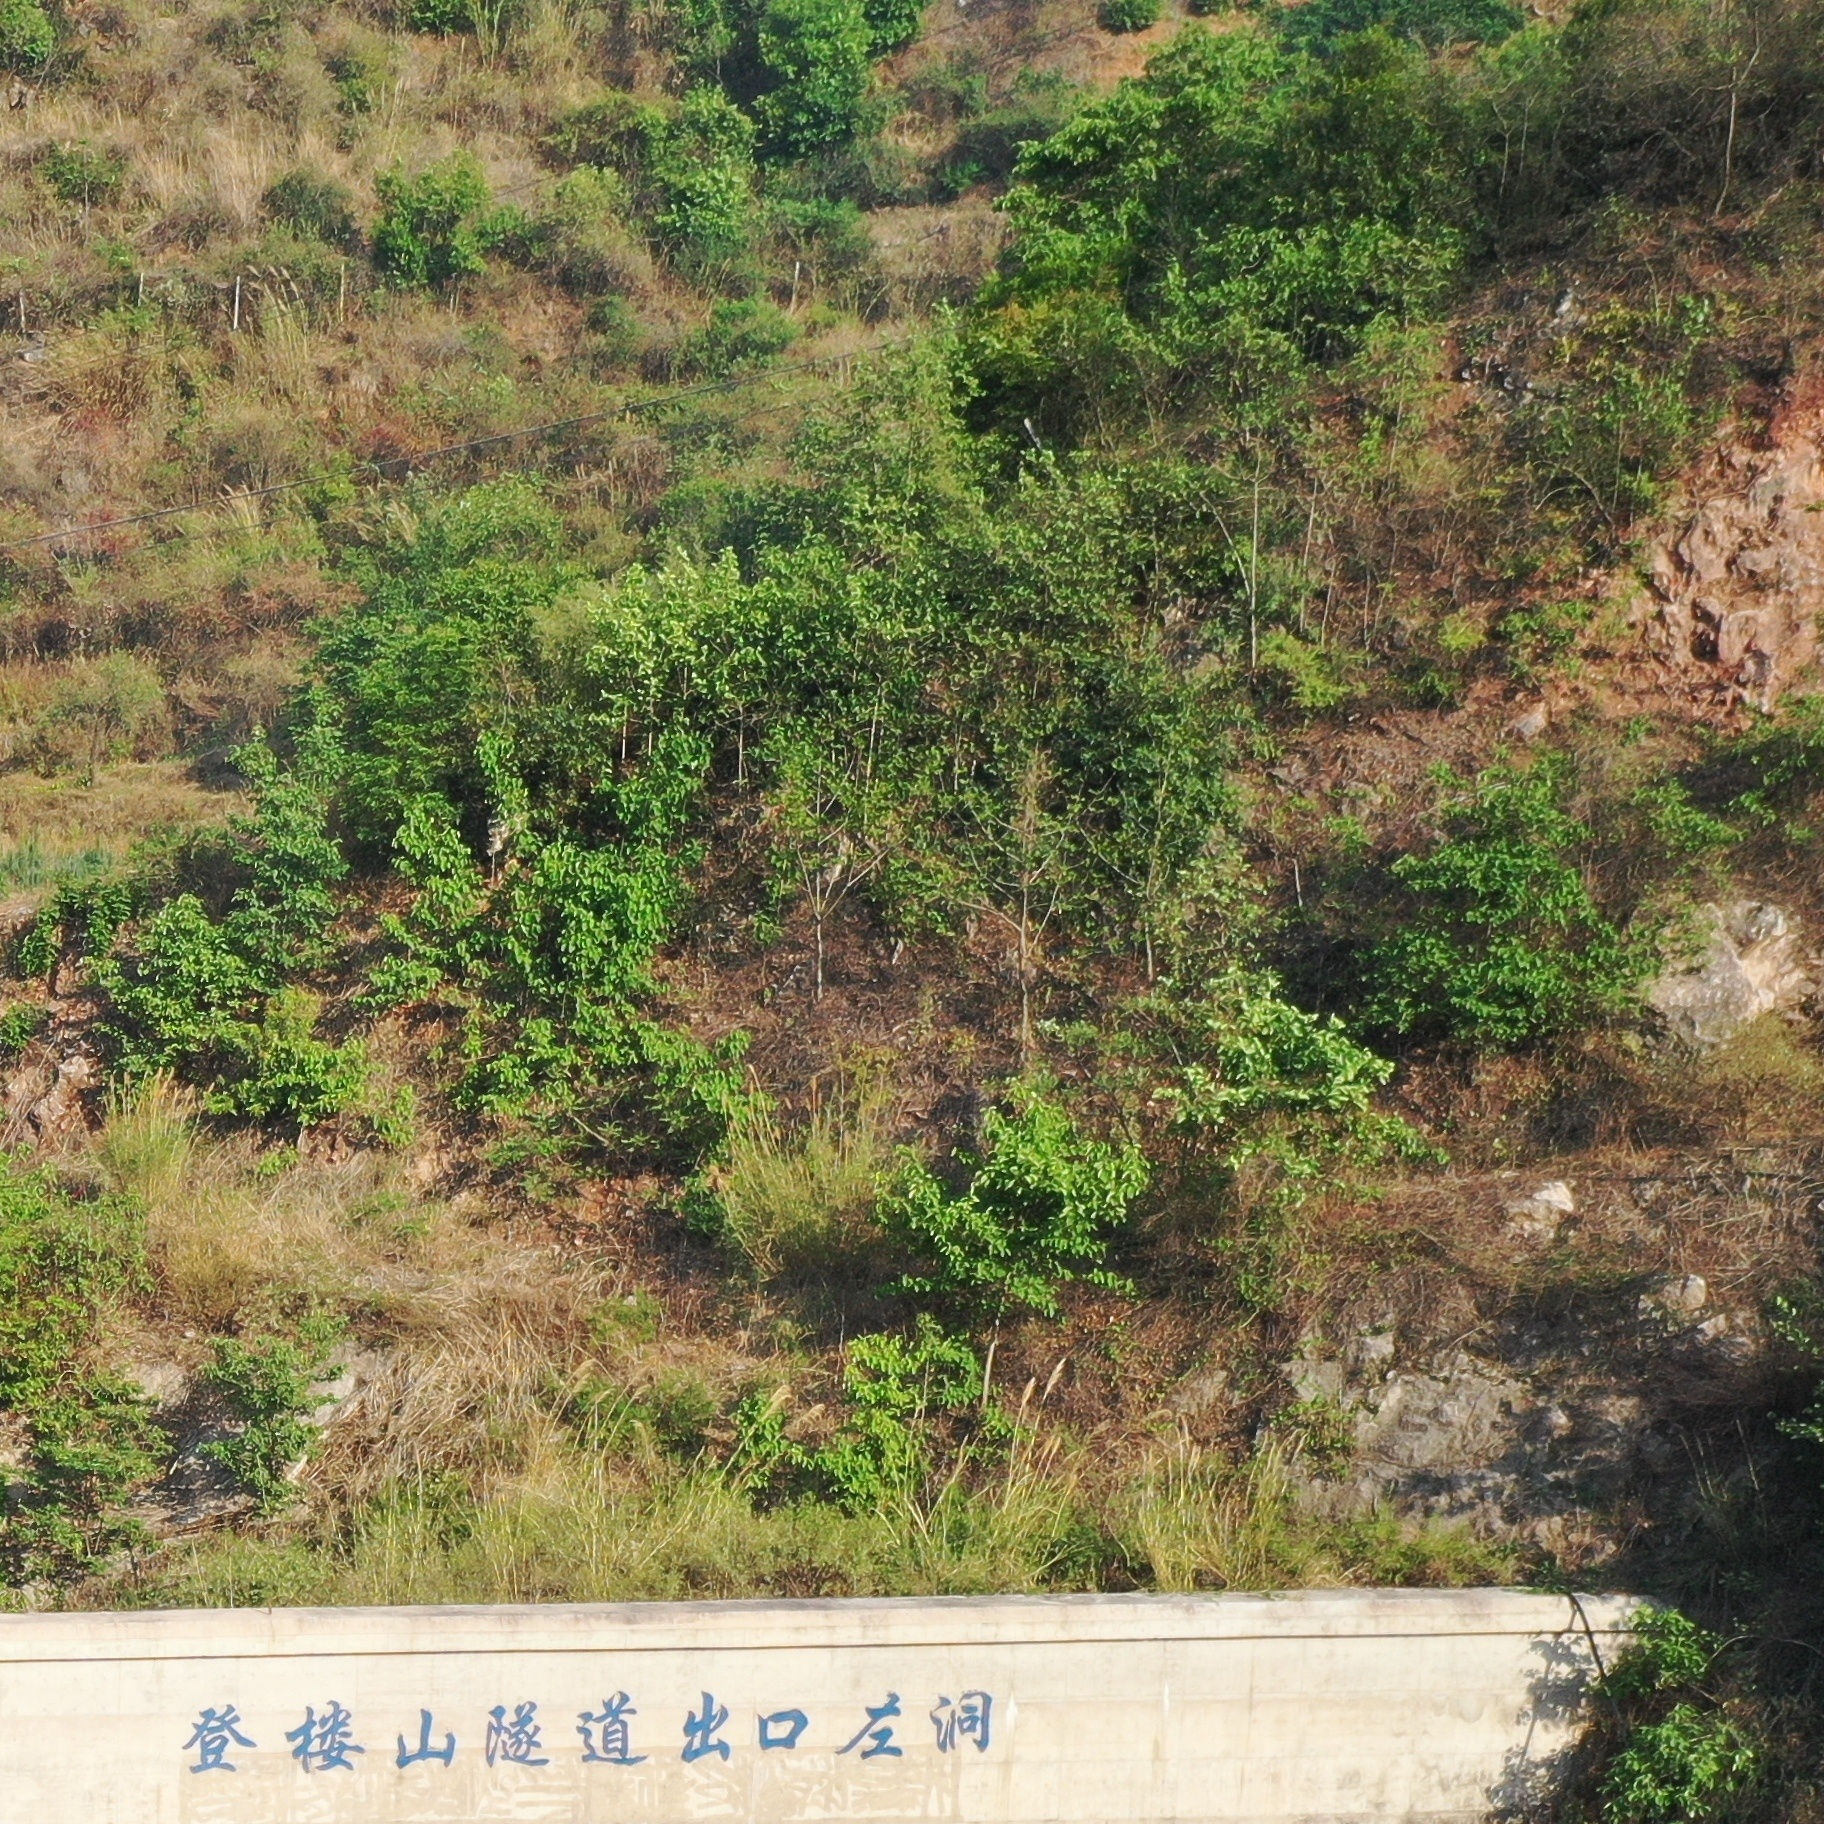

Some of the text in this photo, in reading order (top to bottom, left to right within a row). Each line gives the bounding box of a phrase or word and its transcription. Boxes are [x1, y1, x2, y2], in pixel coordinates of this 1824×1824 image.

[181, 1690, 995, 1776] 登楼山隧道出口左洞
